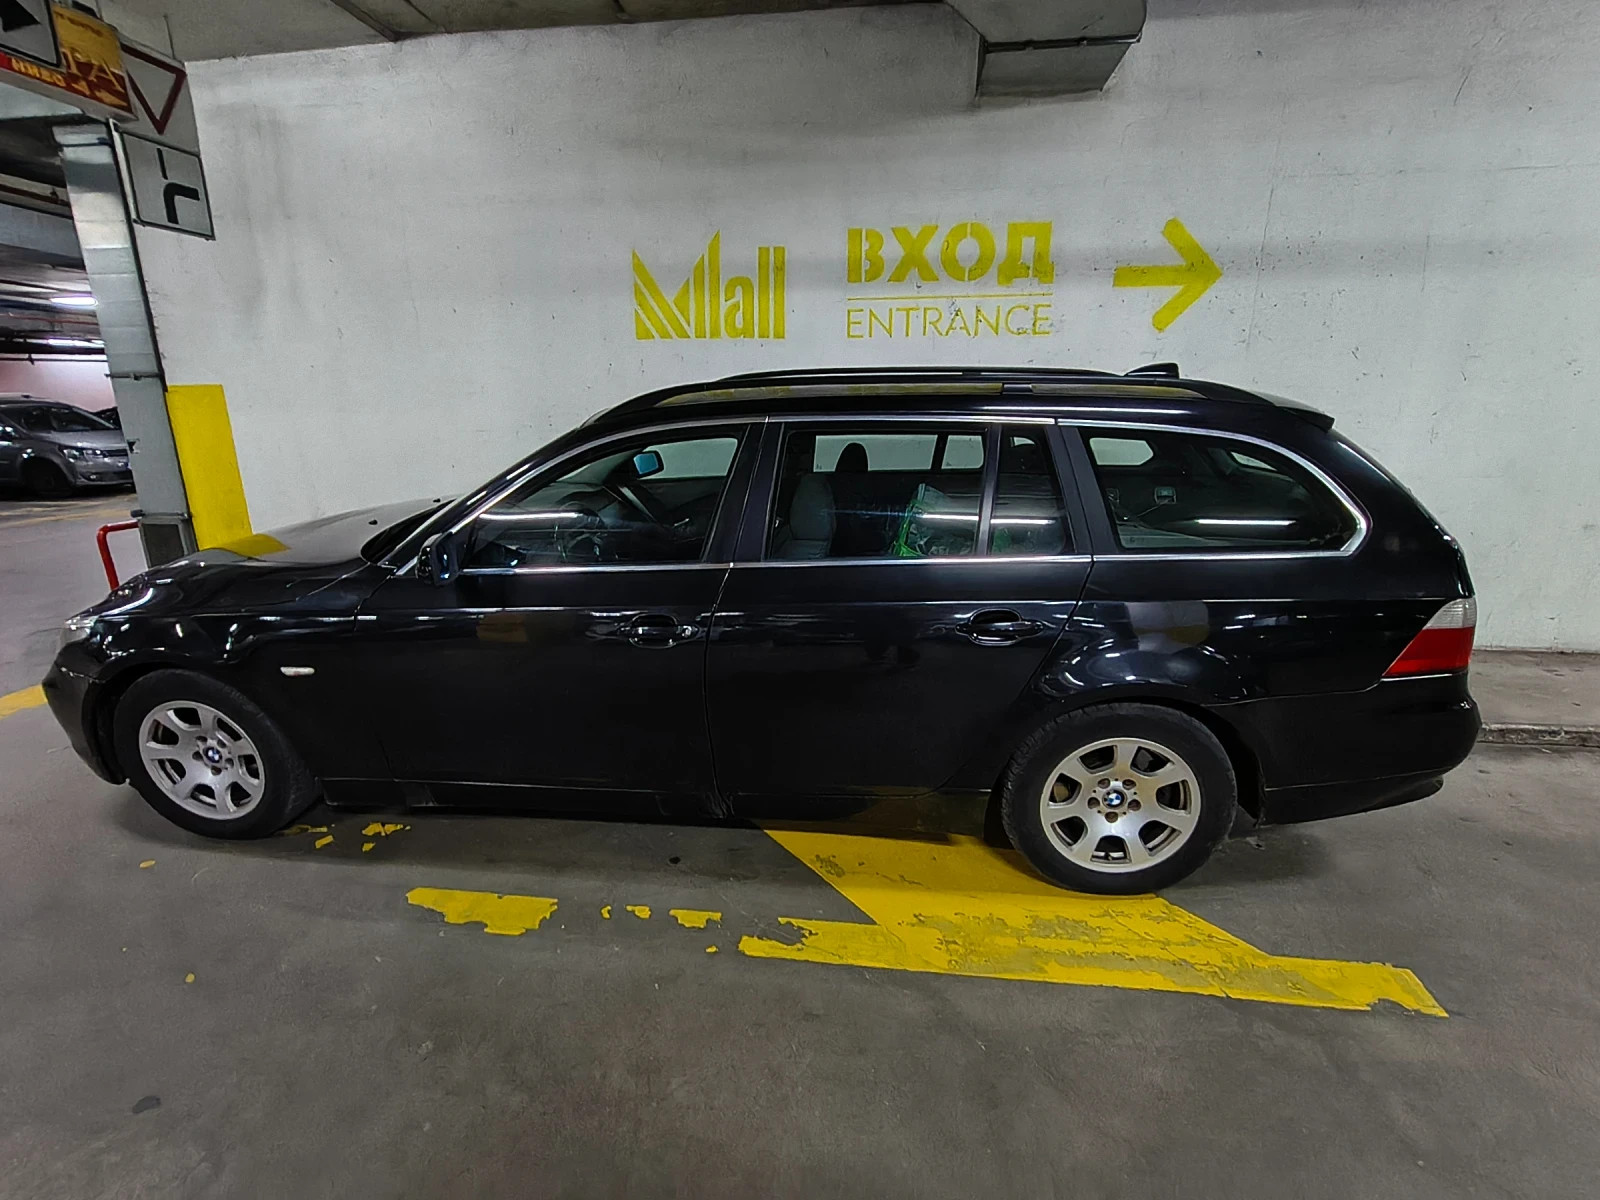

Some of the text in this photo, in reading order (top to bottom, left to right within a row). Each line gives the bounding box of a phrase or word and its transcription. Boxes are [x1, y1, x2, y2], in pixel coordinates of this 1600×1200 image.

[632, 230, 787, 340] Mall
[847, 221, 1055, 286] ВХОД
[847, 303, 1053, 339] ENTRANCE
